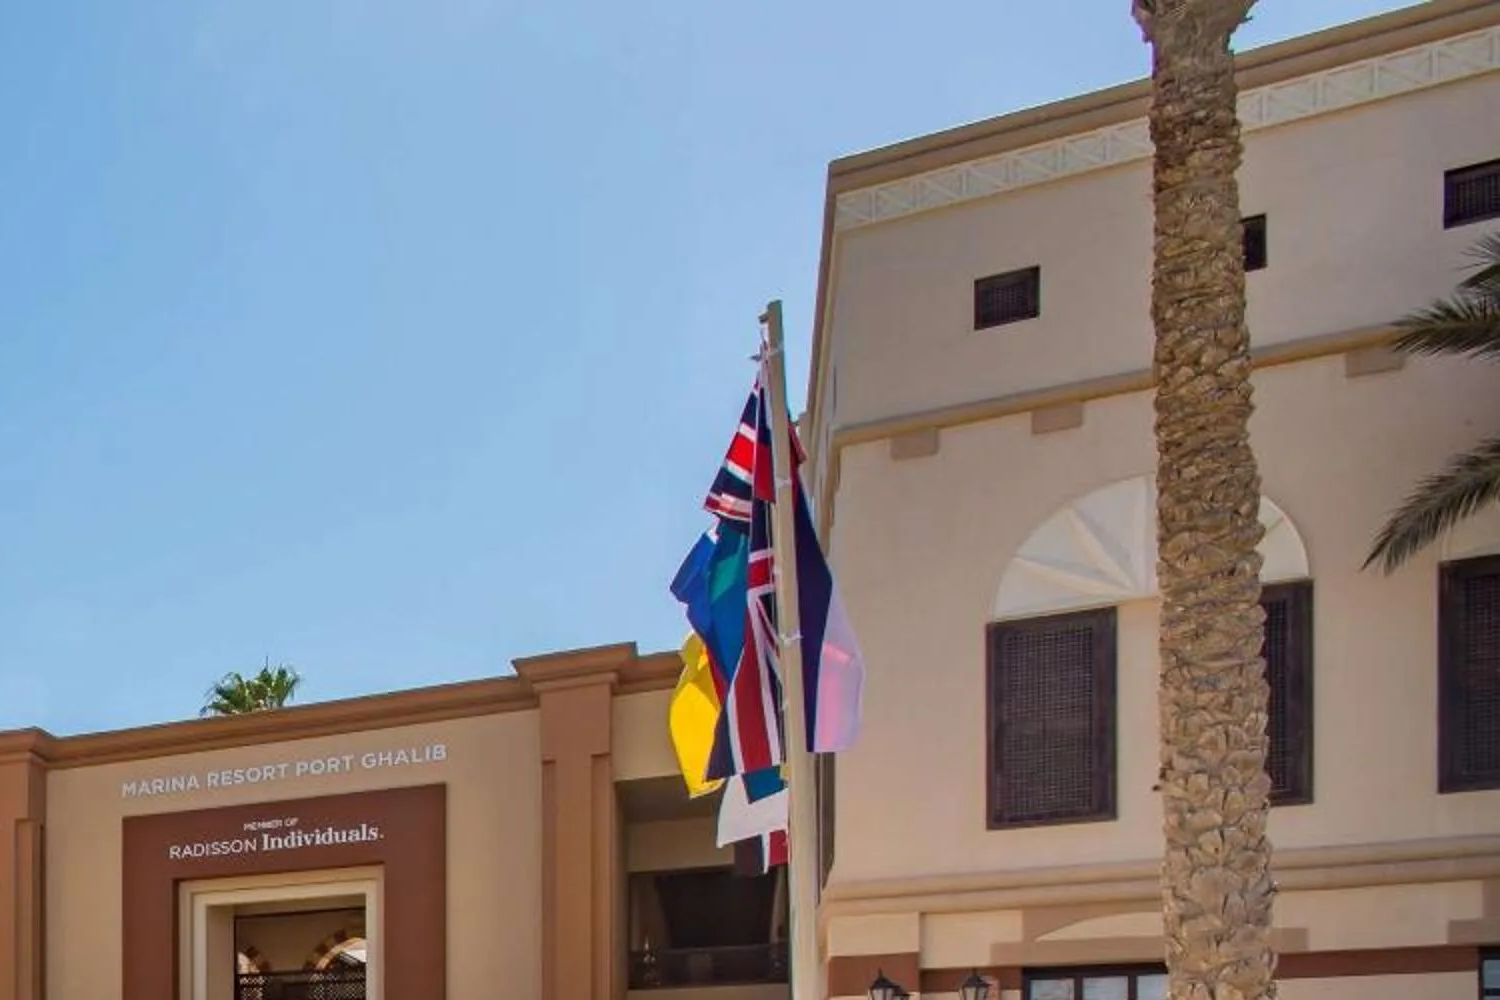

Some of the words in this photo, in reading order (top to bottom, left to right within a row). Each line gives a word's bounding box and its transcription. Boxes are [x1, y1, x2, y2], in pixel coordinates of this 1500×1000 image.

[121, 775, 199, 798] MARINA
[207, 763, 290, 789] RESORT
[296, 755, 354, 777] PORT
[361, 744, 447, 769] GHALIB
[169, 839, 257, 859] RADISSON
